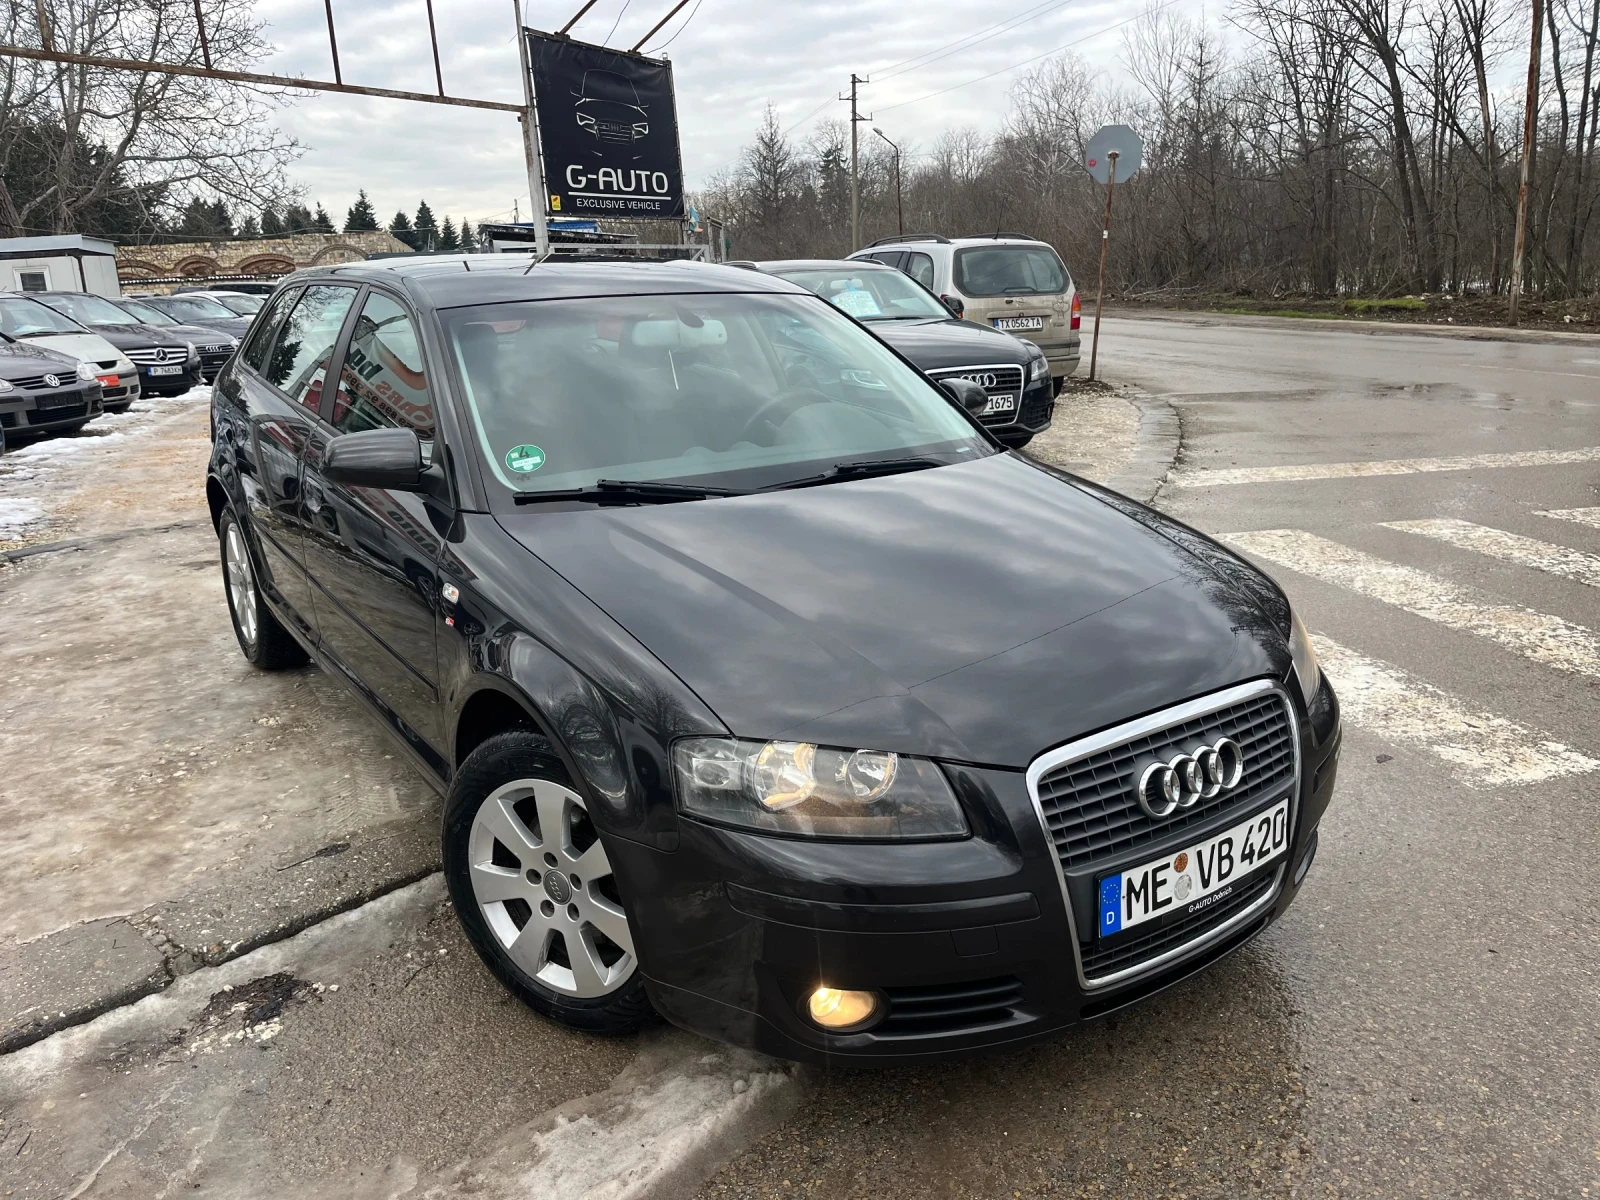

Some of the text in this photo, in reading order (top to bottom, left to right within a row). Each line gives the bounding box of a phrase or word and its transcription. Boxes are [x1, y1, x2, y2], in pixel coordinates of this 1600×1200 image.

[566, 164, 669, 194] G-AUTO
[577, 198, 661, 210] EXCLUSIVE VEHICLE
[1000, 318, 1010, 329] TX
[1011, 318, 1030, 328] 0562
[1031, 317, 1042, 327] TA
[988, 396, 1013, 409] 1675
[519, 446, 531, 459] 4
[1126, 806, 1286, 921] ME VB 420
[1188, 897, 1212, 913] G-AUTO
[1106, 911, 1115, 925] D
